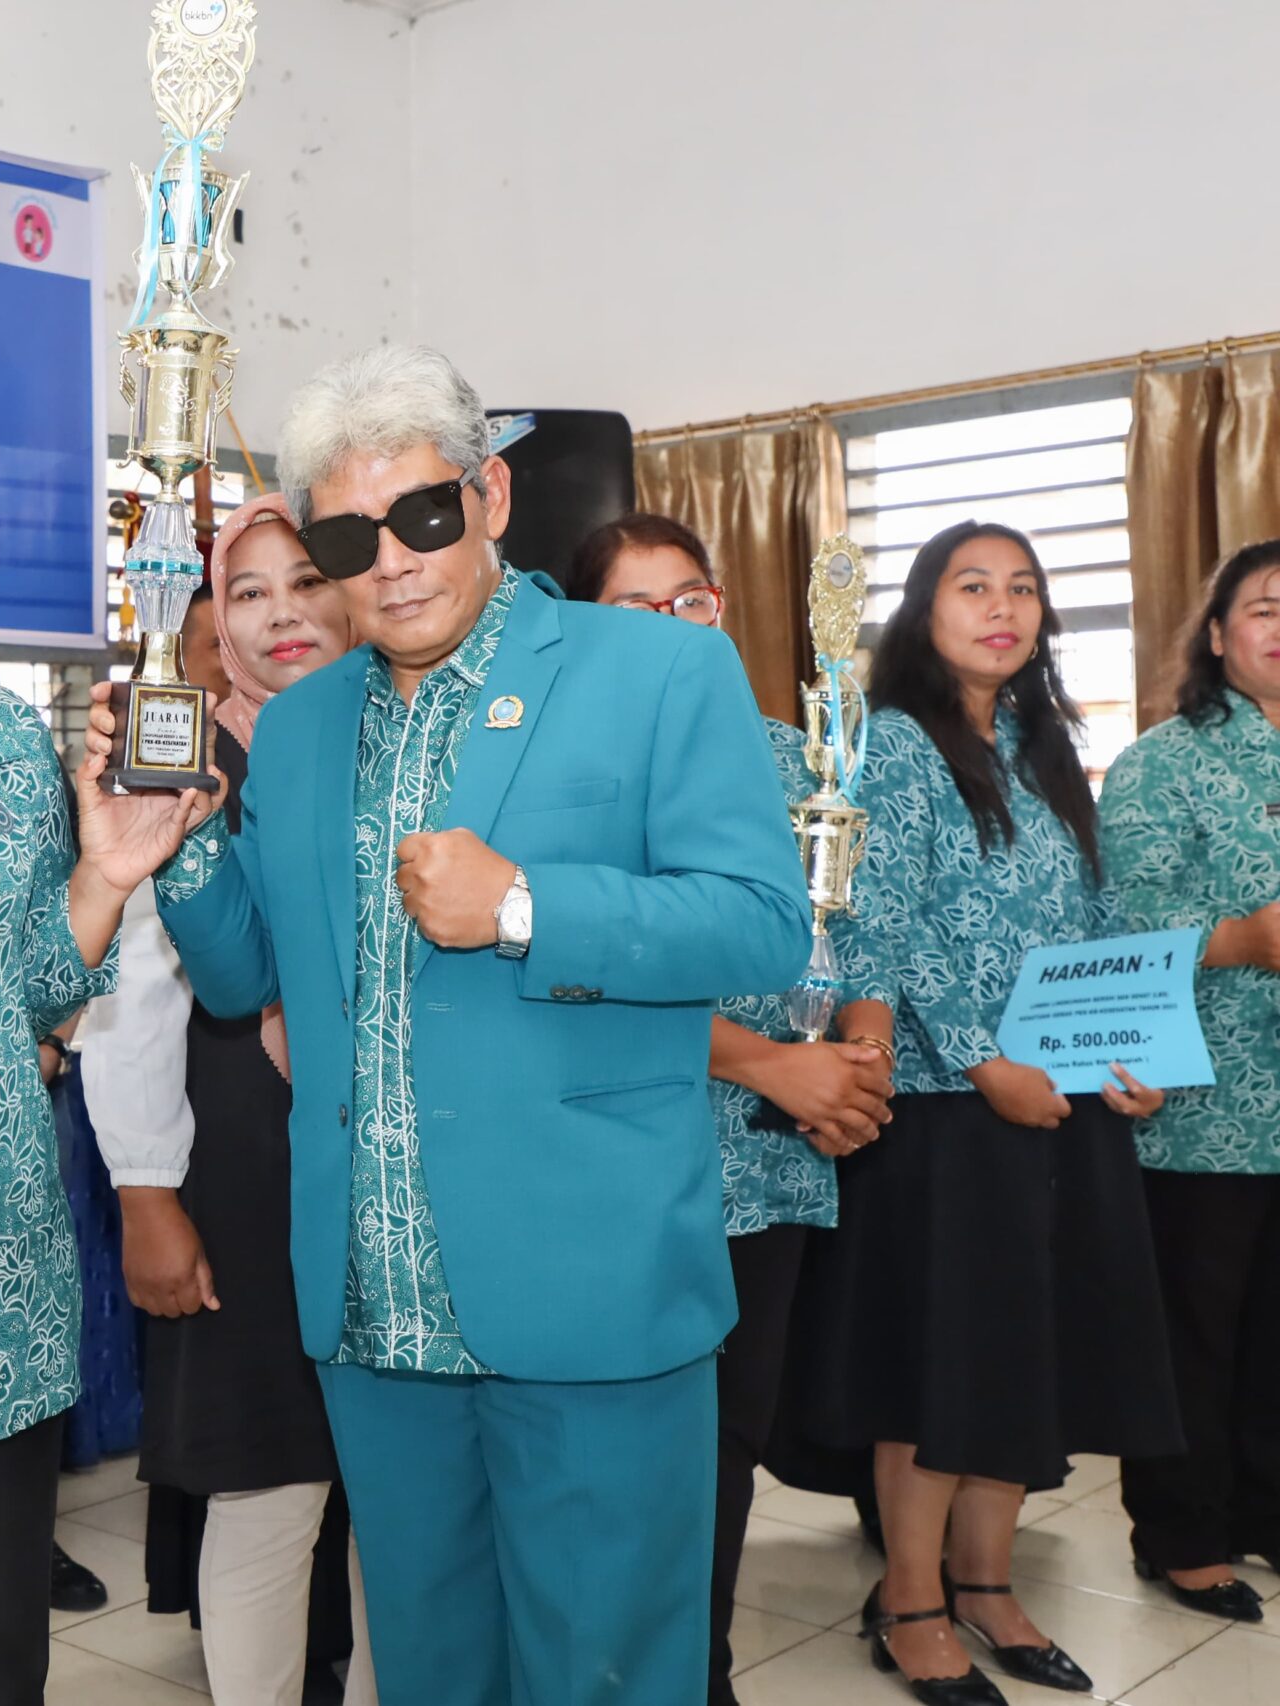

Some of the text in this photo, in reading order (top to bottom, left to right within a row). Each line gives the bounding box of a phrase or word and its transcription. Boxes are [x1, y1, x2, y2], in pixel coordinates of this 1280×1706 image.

[185, 11, 213, 20] bkkbn
[144, 711, 179, 723] JUARA
[1039, 954, 1143, 984] HARAPAN
[1163, 952, 1173, 970] 1
[1039, 1029, 1153, 1053] Rp. 500.000.-
